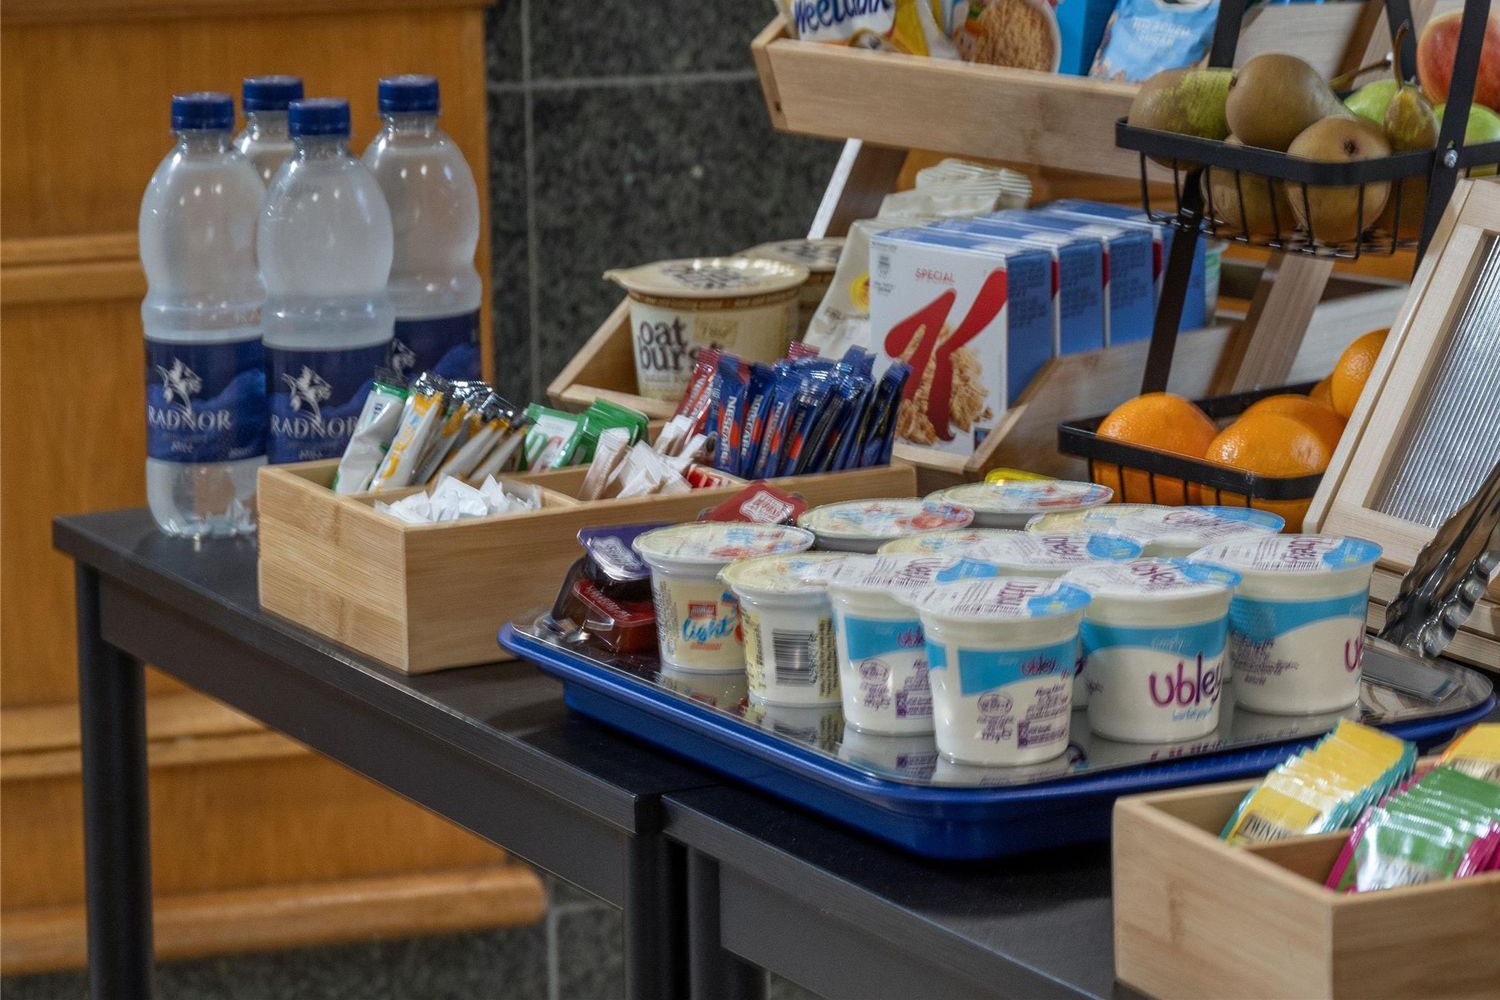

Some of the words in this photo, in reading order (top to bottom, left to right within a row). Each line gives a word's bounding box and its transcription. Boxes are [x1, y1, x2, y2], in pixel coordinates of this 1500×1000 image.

[914, 267, 956, 284] SPECIAL
[639, 316, 687, 347] oat
[148, 404, 233, 432] RADNOR
[271, 414, 358, 439] RADNOR
